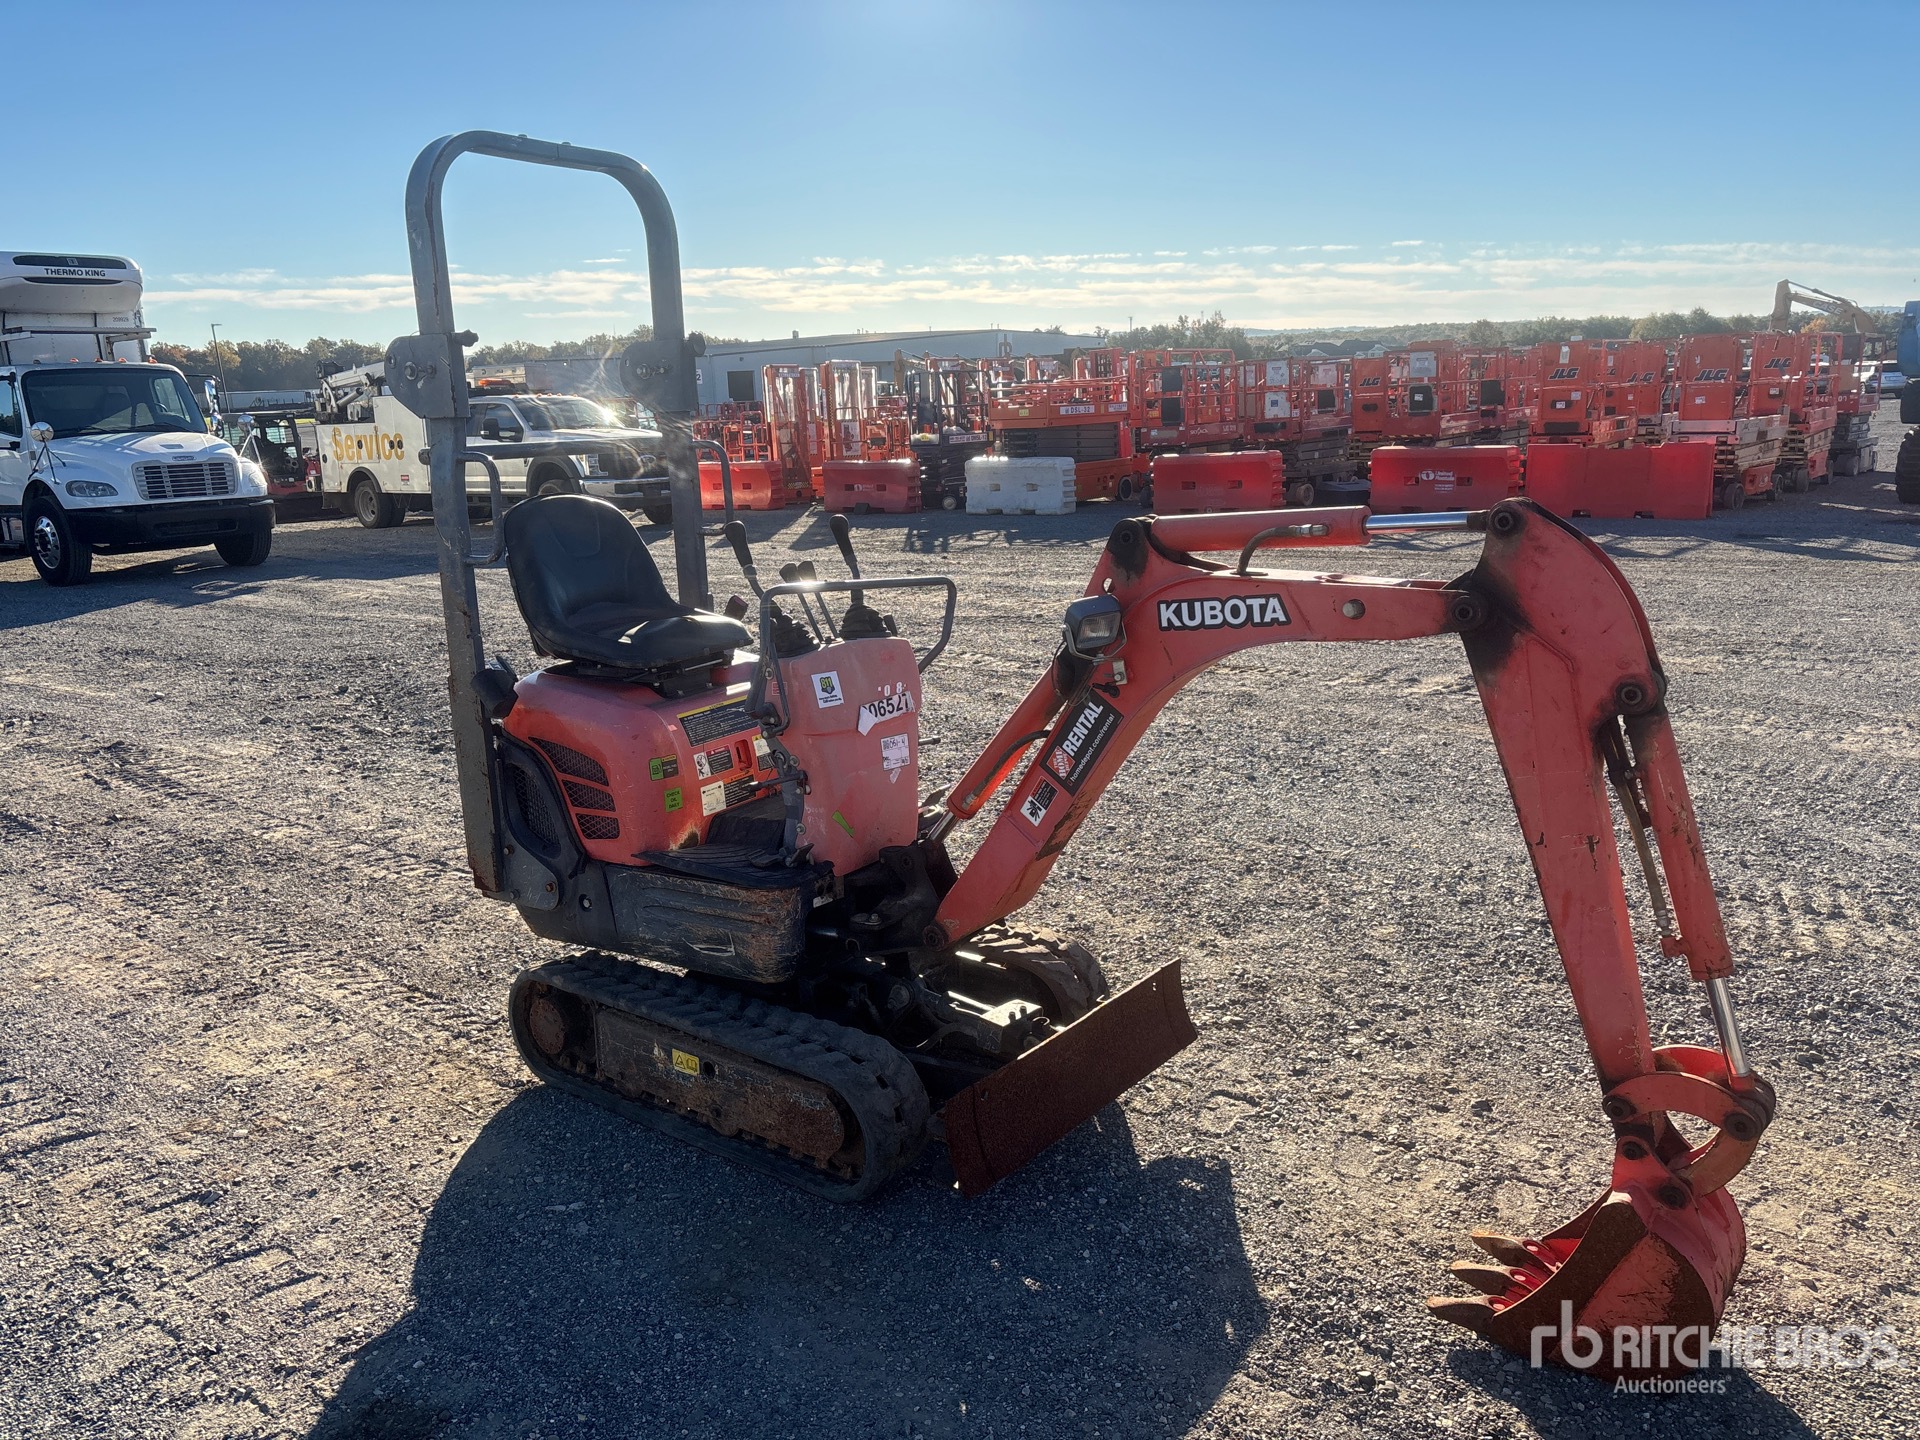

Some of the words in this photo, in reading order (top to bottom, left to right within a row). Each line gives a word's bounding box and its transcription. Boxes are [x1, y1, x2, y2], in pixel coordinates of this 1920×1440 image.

[44, 268, 83, 276] THERMO
[84, 269, 106, 277] KING
[1812, 300, 1843, 315] CASE
[1764, 358, 1792, 369] JLG
[1548, 368, 1580, 380] JLG
[1694, 369, 1729, 381] JLG
[1360, 377, 1381, 387] JLG
[1070, 406, 1091, 414] DSL-32
[332, 425, 405, 461] Service
[1160, 597, 1287, 627] KUBOTA
[821, 677, 832, 689] 811
[1061, 701, 1104, 756] RENTAL
[1071, 713, 1115, 782] homedepot.com/rental
[1055, 750, 1067, 777] HOME
